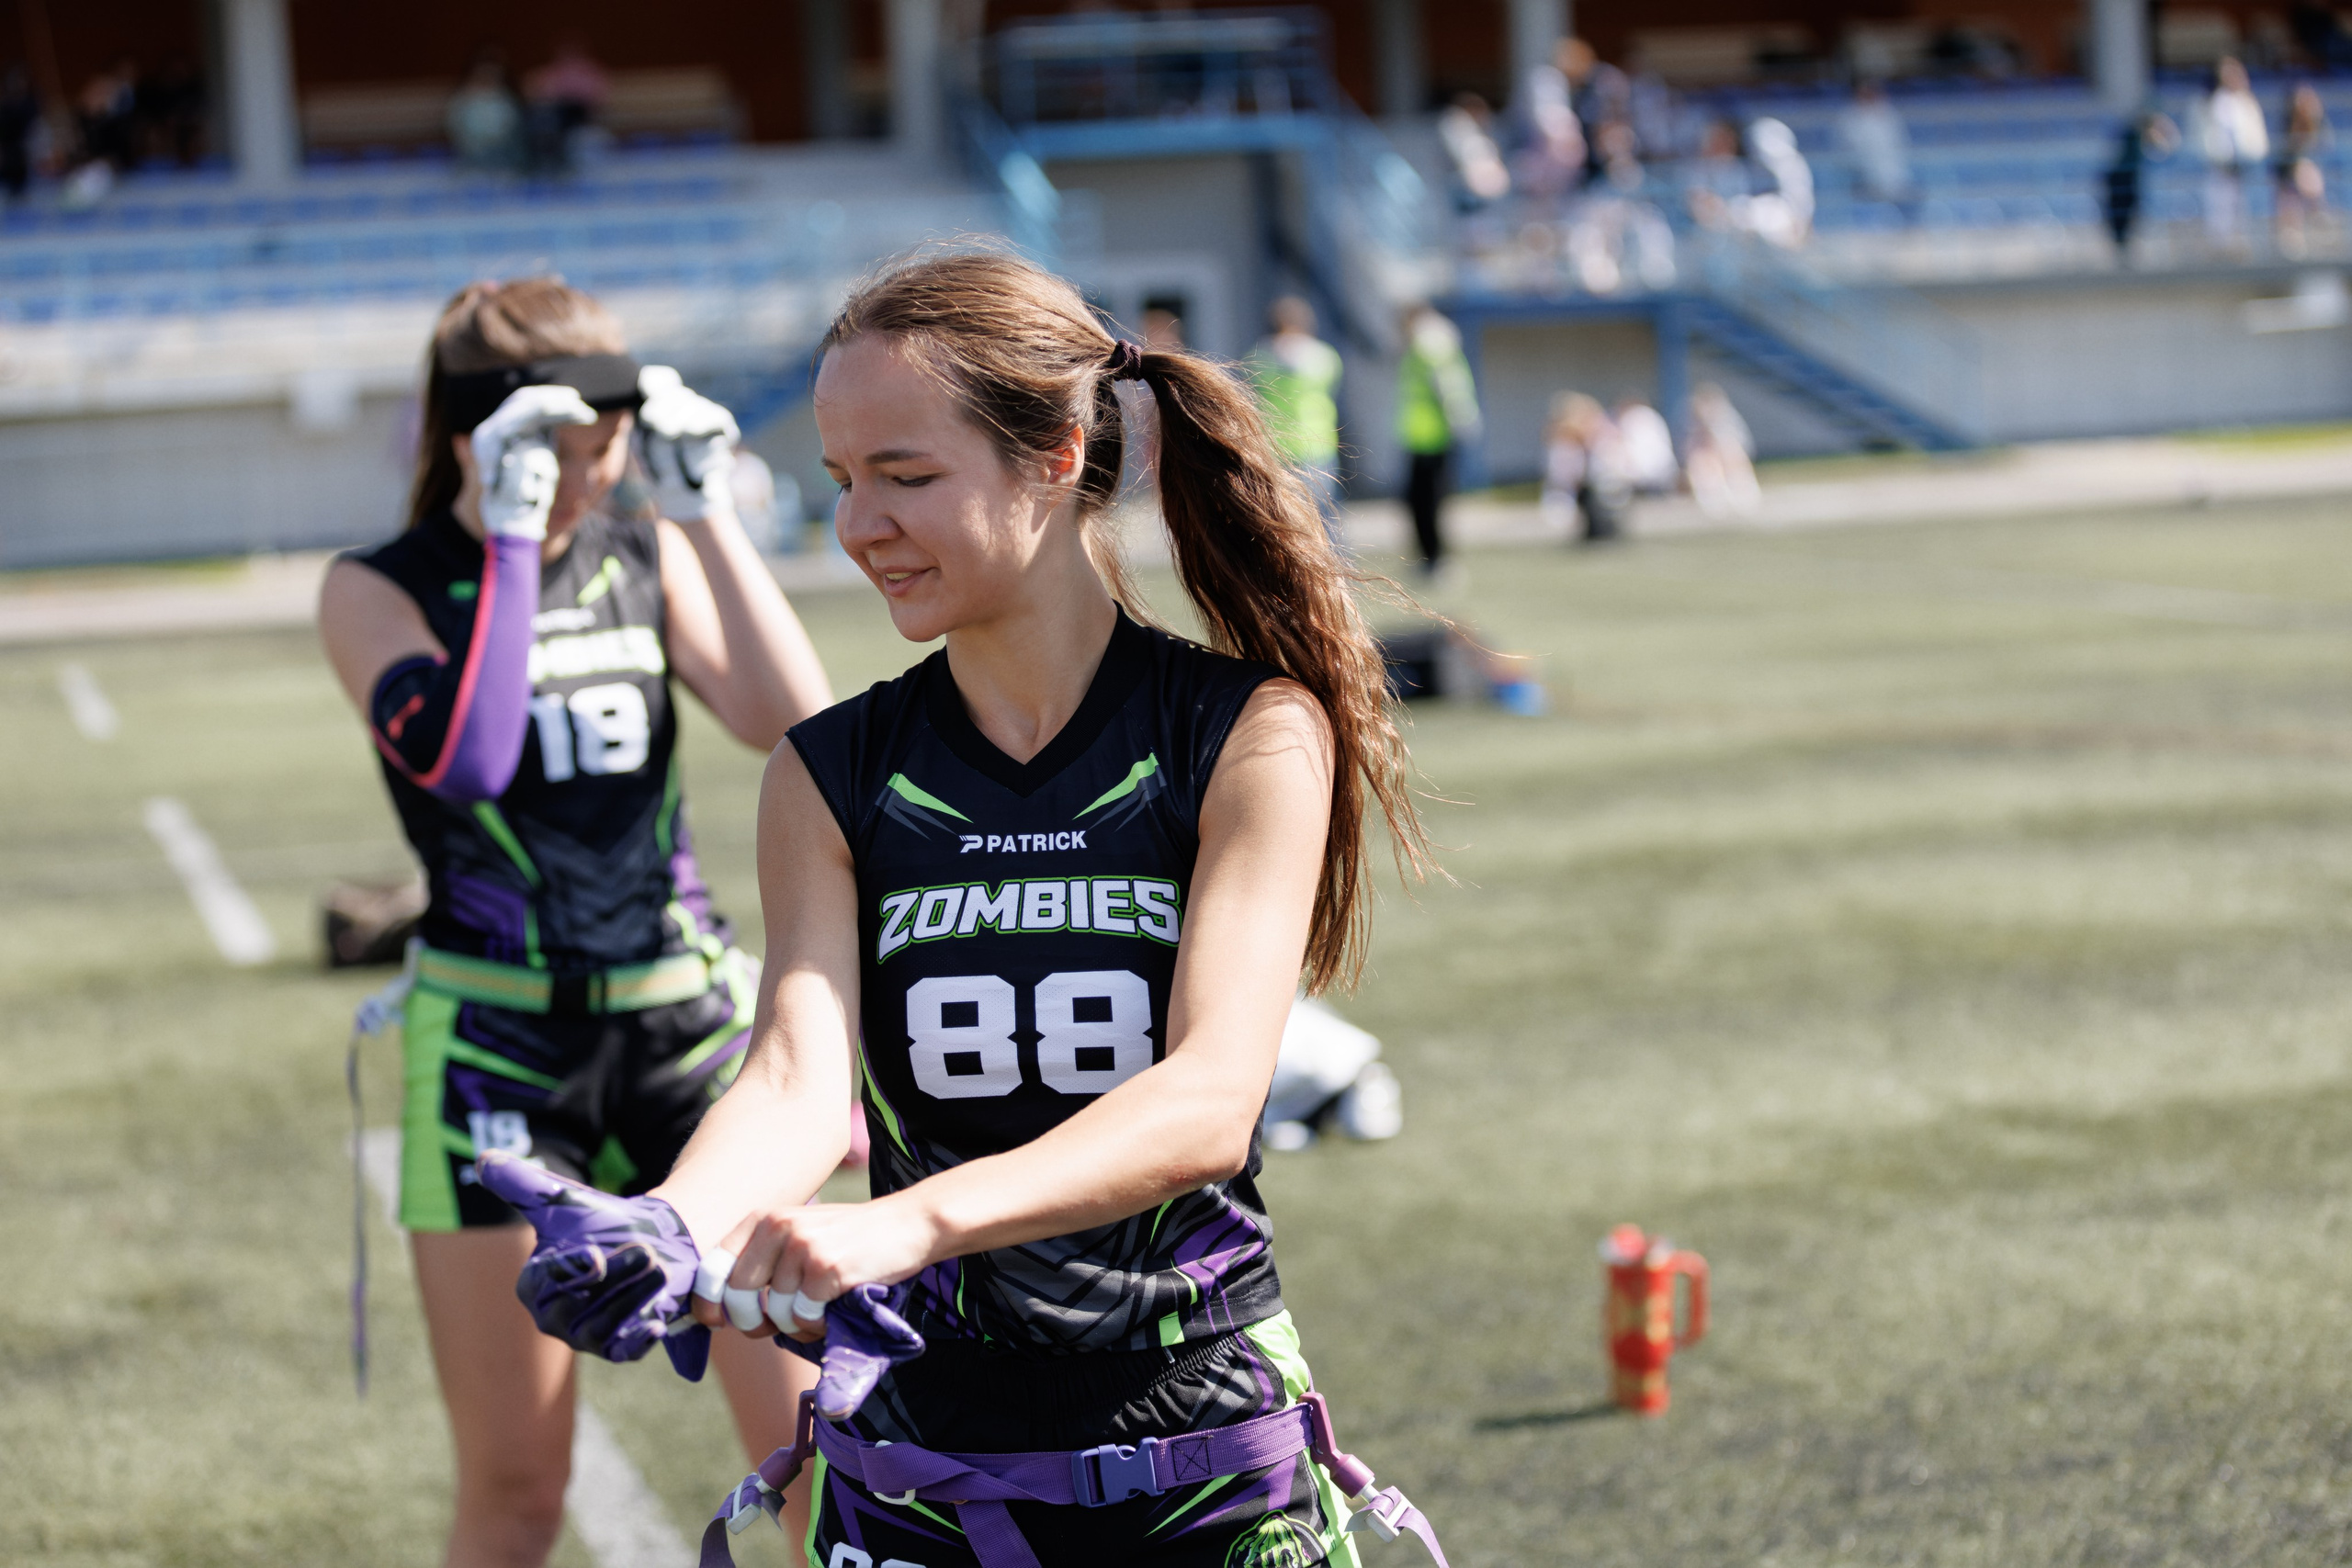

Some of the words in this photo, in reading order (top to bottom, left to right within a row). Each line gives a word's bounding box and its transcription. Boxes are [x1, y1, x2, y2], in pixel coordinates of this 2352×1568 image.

[529, 682, 650, 784] 18
[987, 830, 1087, 852] PATRICK
[876, 875, 1181, 964] ZOMBIES
[906, 970, 1153, 1100] 88
